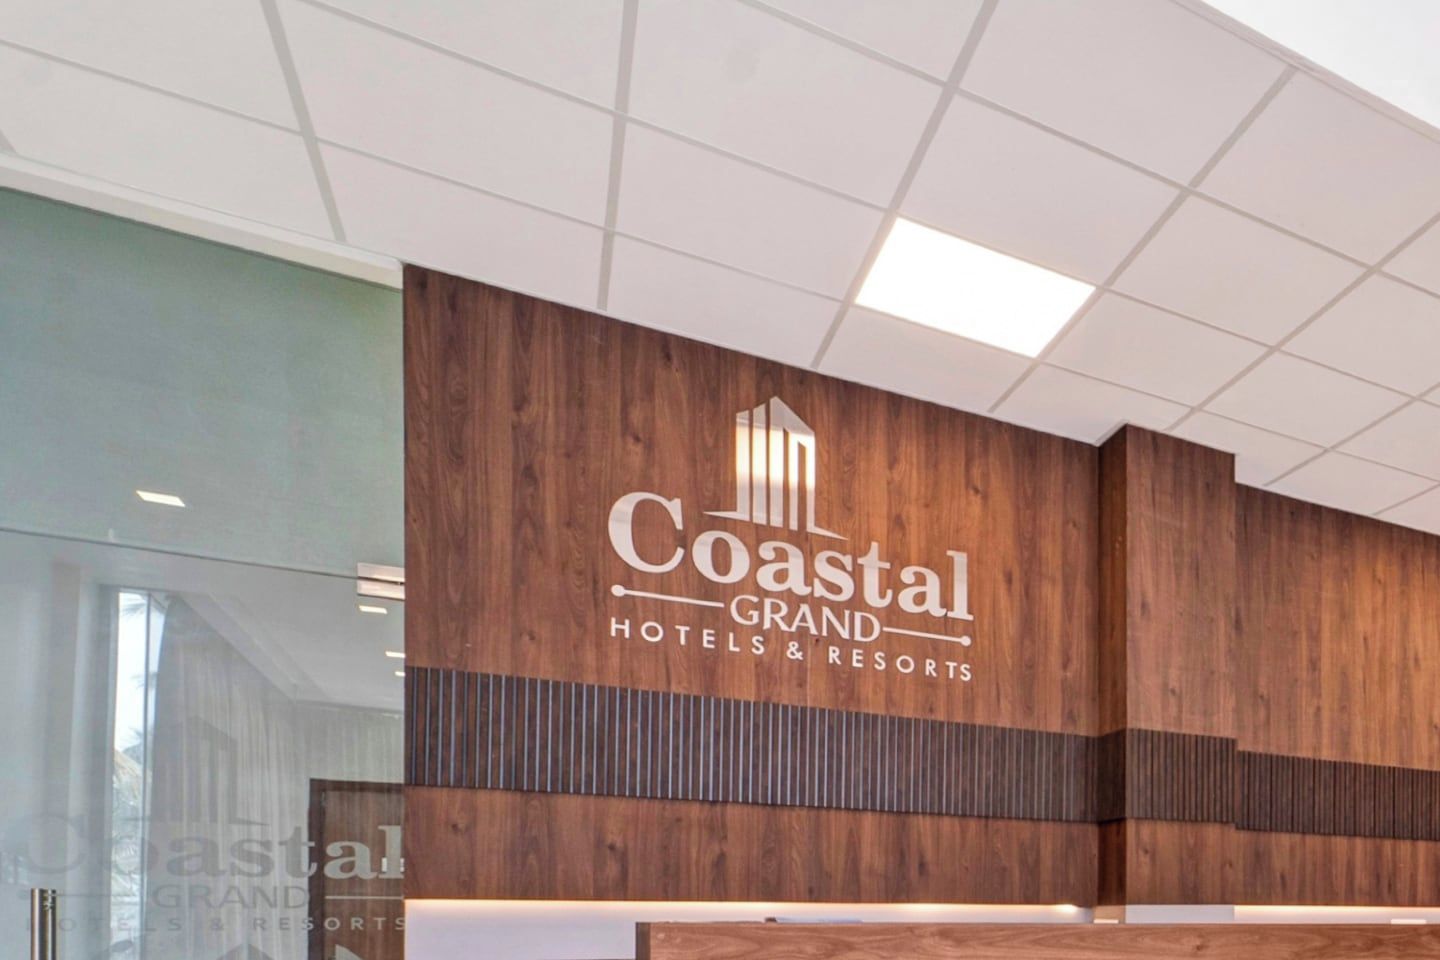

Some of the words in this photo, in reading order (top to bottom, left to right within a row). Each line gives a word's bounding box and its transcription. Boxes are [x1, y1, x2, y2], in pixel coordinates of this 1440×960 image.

[608, 491, 974, 620] Coastal
[730, 595, 881, 642] GRAND
[610, 617, 766, 656] HOTELS
[786, 641, 804, 661] &
[828, 646, 973, 682] RESORTS
[152, 884, 309, 909] GRAND
[211, 916, 225, 931] &
[253, 916, 405, 931] RESORTS
